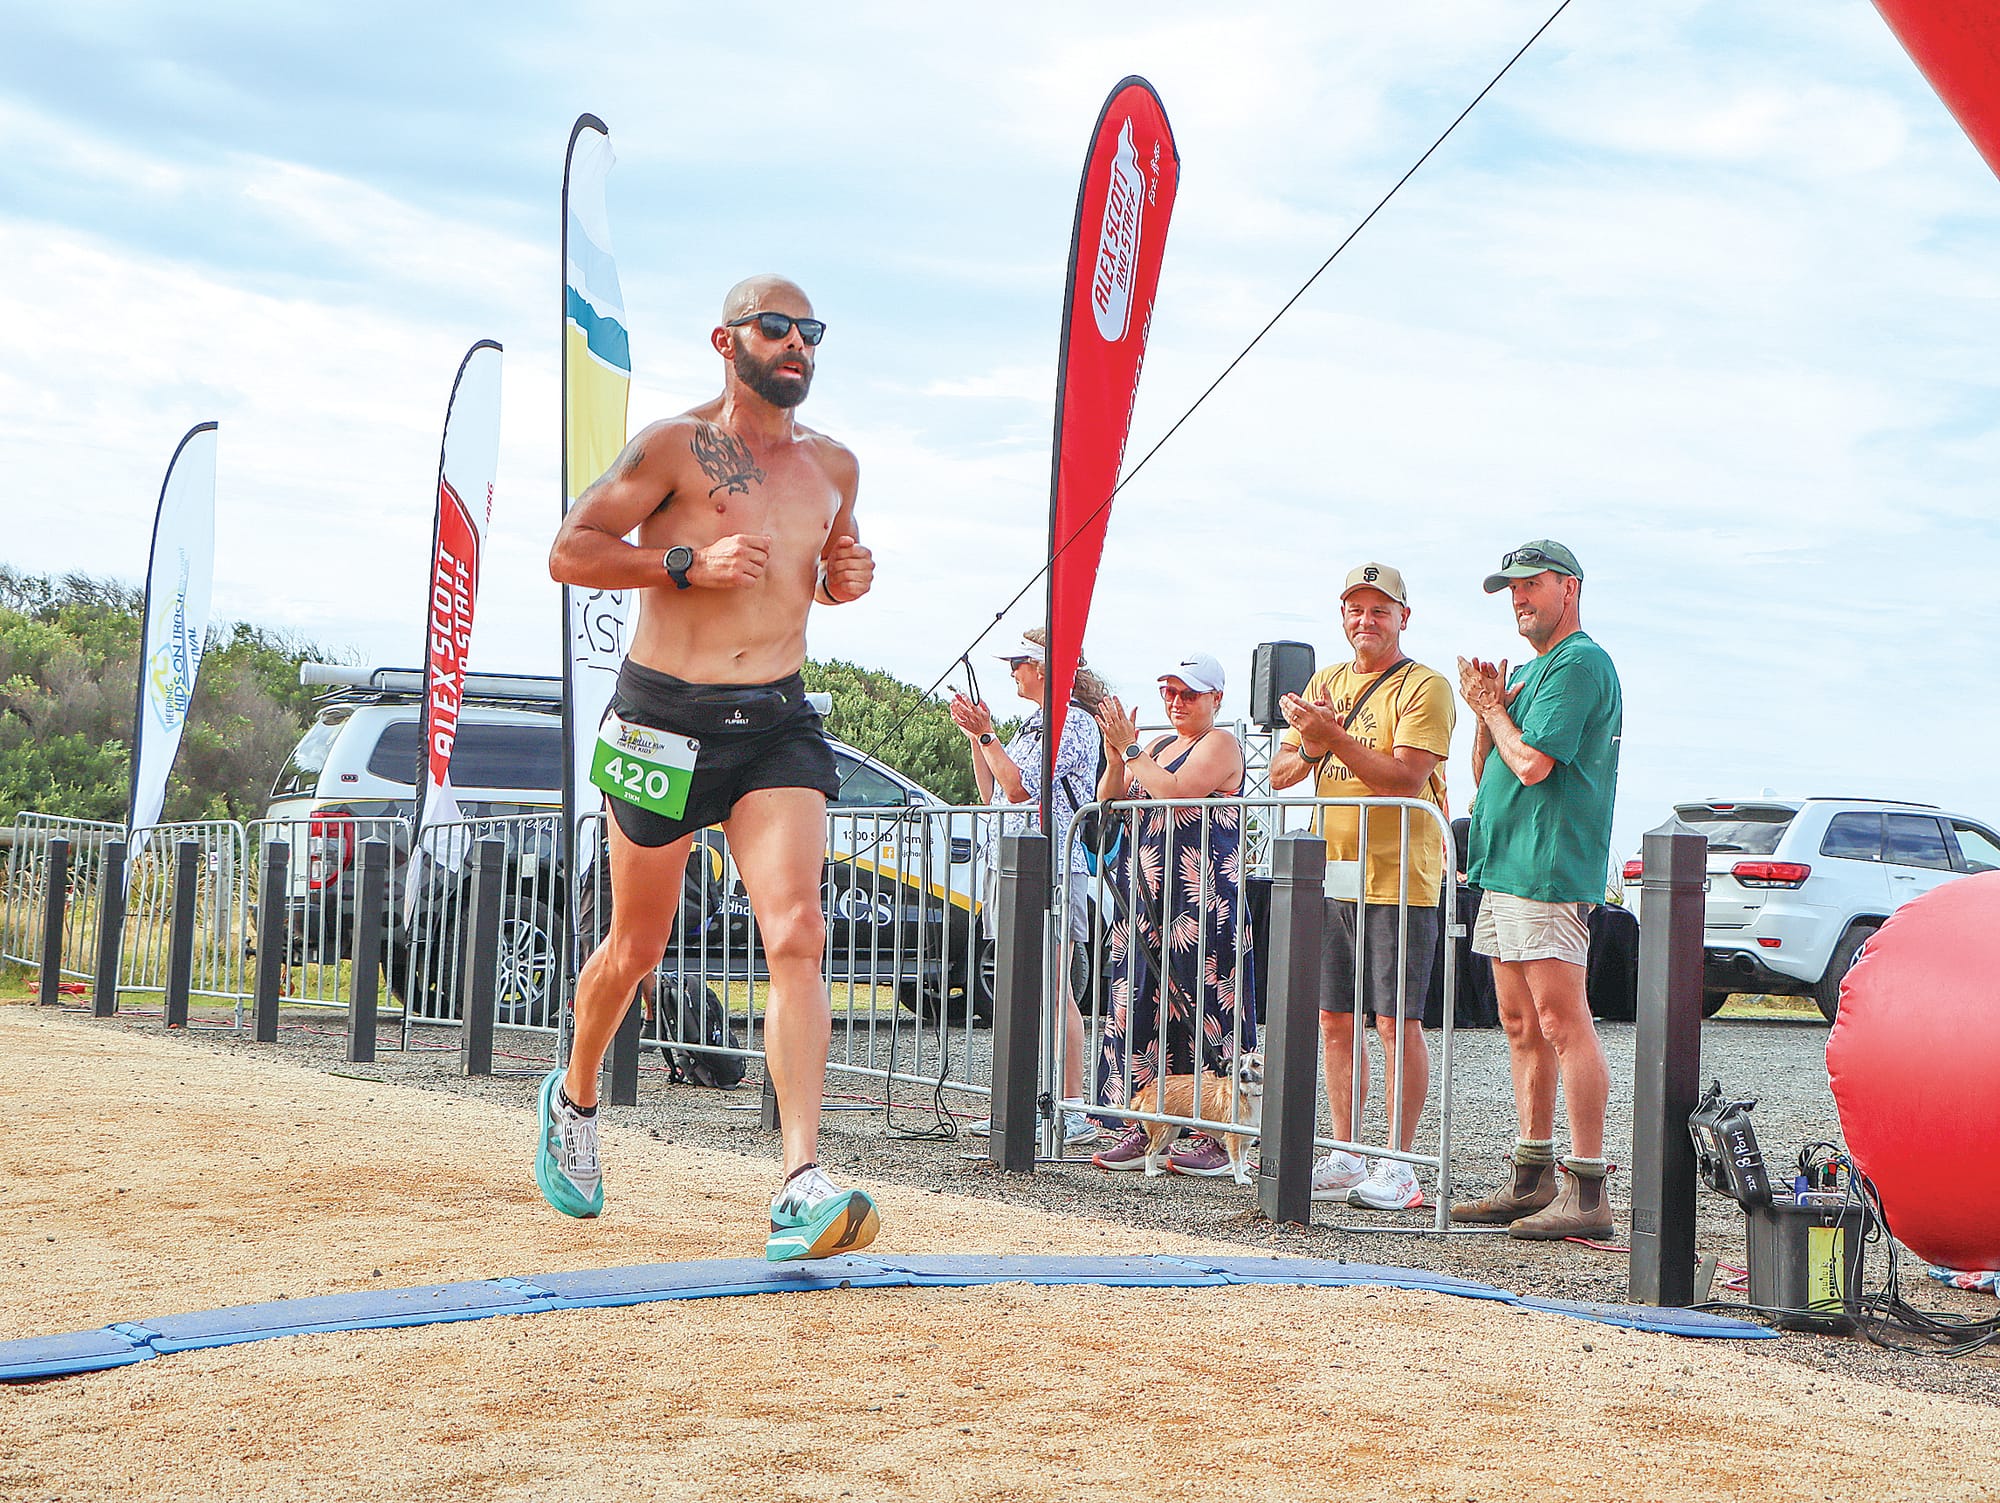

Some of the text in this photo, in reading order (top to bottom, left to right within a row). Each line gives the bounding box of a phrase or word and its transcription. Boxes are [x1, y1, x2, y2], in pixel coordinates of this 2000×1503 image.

[1094, 160, 1129, 315] ALEX SCOTT
[1115, 186, 1137, 292] AND STAFF
[455, 559, 472, 646] STAFF
[173, 644, 185, 673] ON
[431, 540, 458, 760] ALEX SCOTT
[638, 746, 652, 754] KIDS
[604, 756, 670, 800] 420
[623, 791, 641, 803] 21KM
[1732, 1130, 1750, 1155] Port
